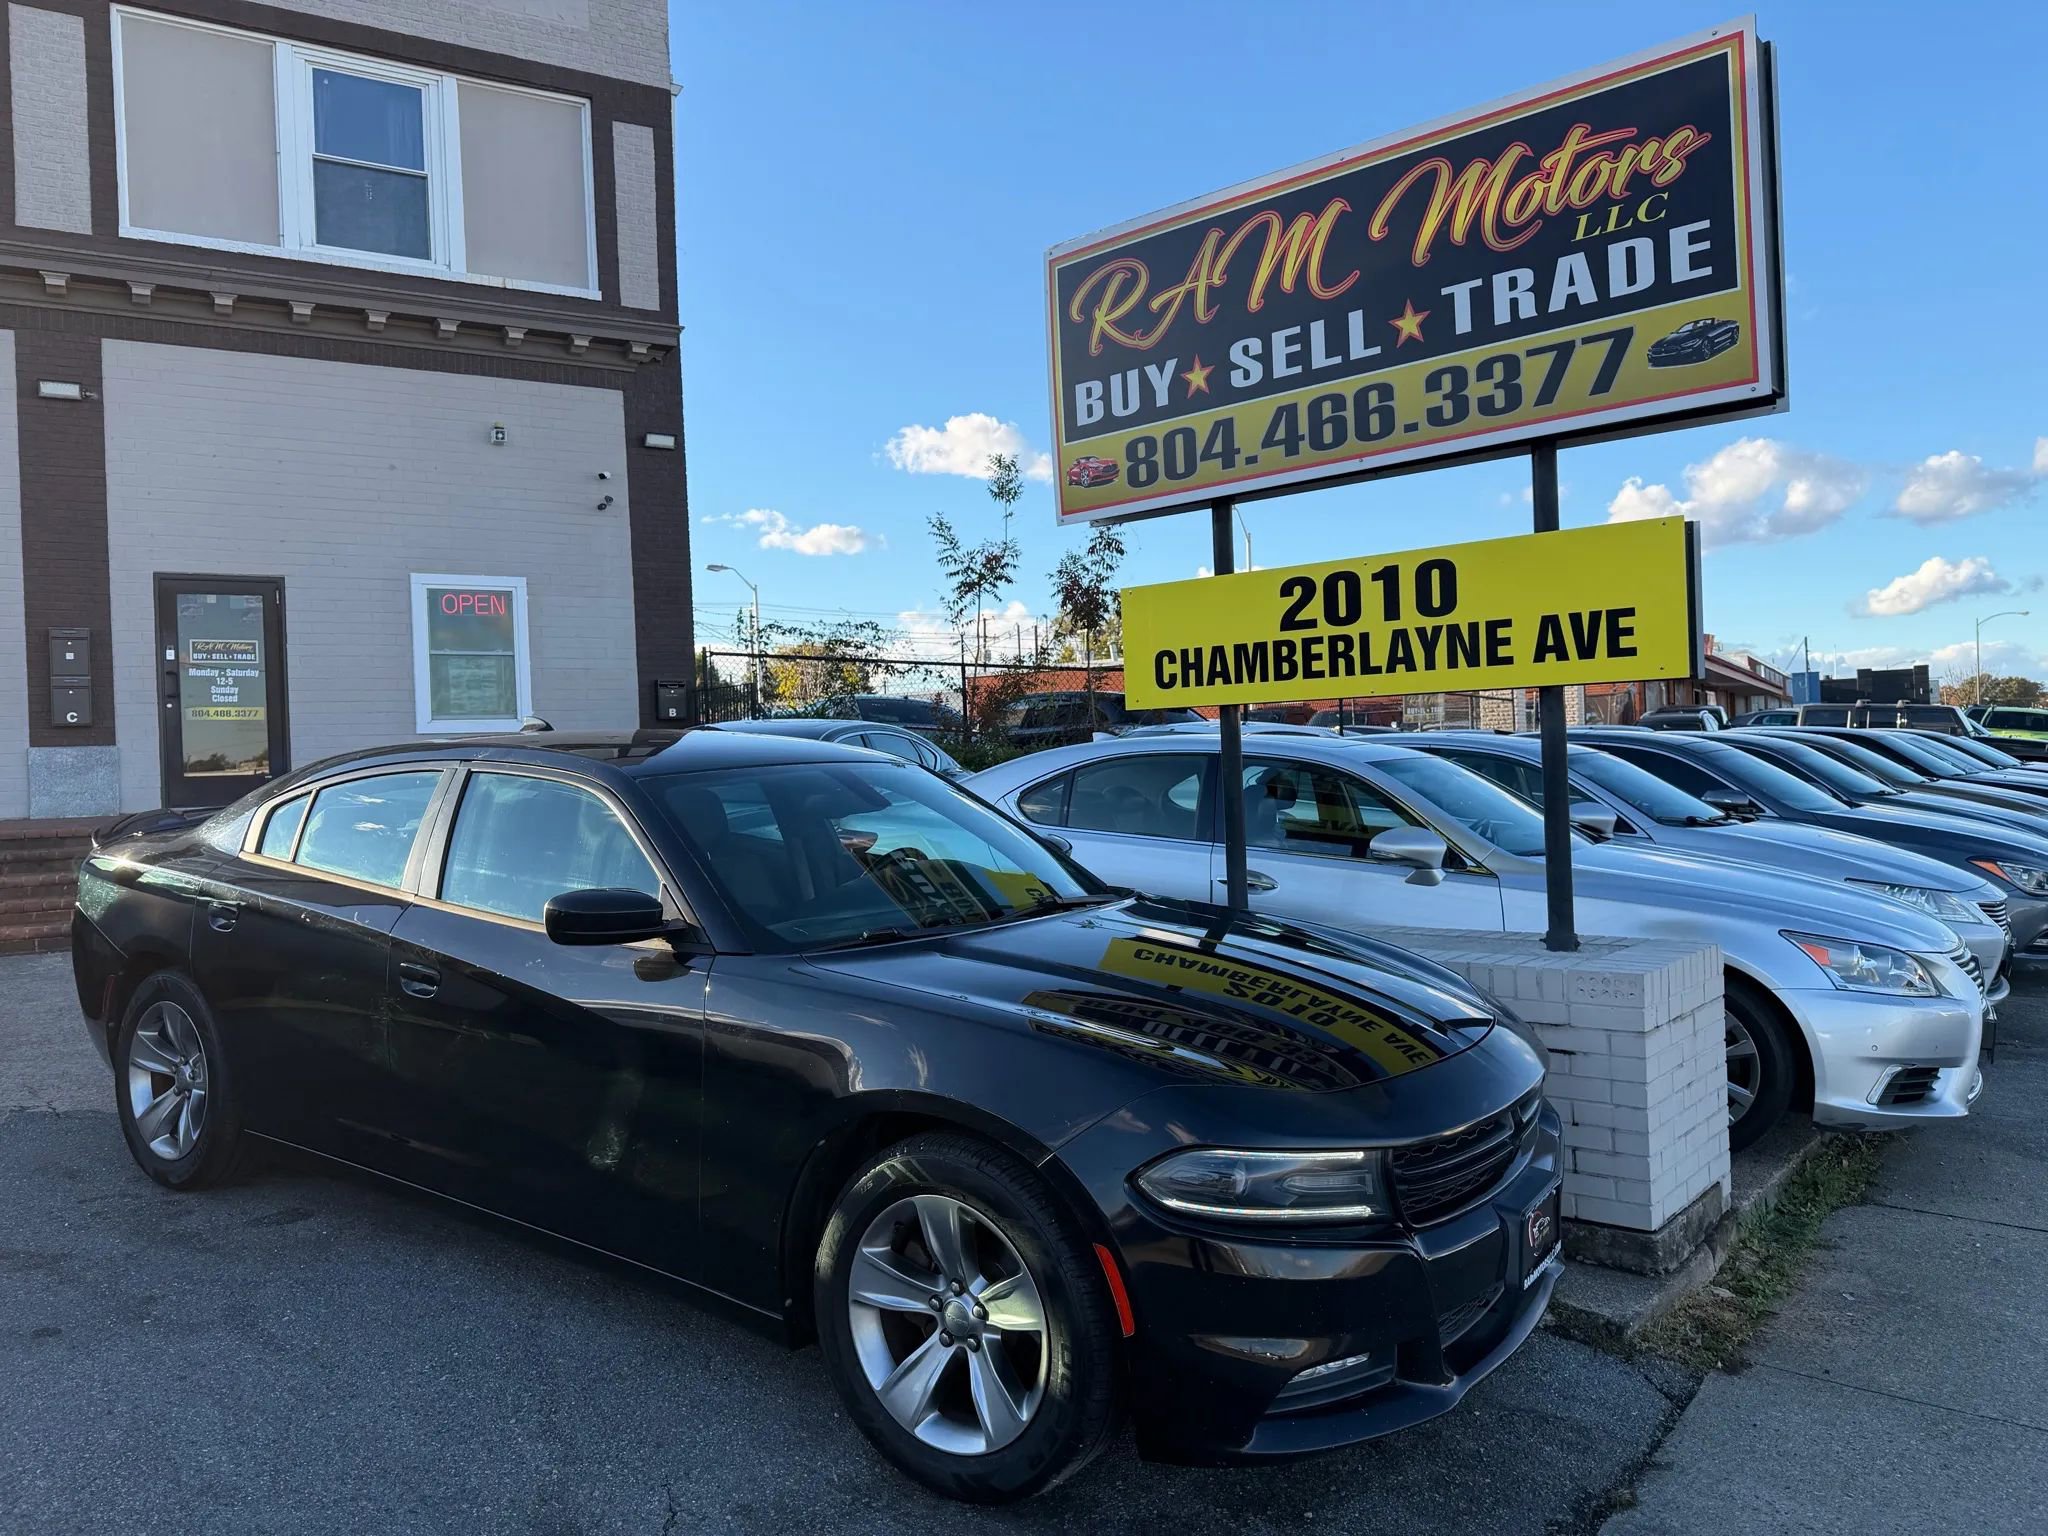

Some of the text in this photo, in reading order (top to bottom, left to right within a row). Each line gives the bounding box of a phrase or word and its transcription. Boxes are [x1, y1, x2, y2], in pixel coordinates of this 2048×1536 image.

[1571, 191, 1669, 242] LLC
[1069, 123, 1712, 356] RAM Motors
[1075, 219, 1713, 427] BUY SELL TRADE
[1125, 326, 1635, 489] 804.466.3377
[1279, 558, 1457, 632] 2010
[442, 594, 505, 615] OPEN
[1154, 607, 1638, 690] CHAMBERLAYNE AVE
[233, 653, 256, 661] TRADE
[188, 668, 219, 678] Monday
[226, 668, 259, 678] Saturday
[216, 677, 234, 685] 12-5
[210, 686, 239, 695] Sunday
[212, 694, 238, 703] Closed
[66, 711, 78, 723] C
[668, 708, 677, 717] B
